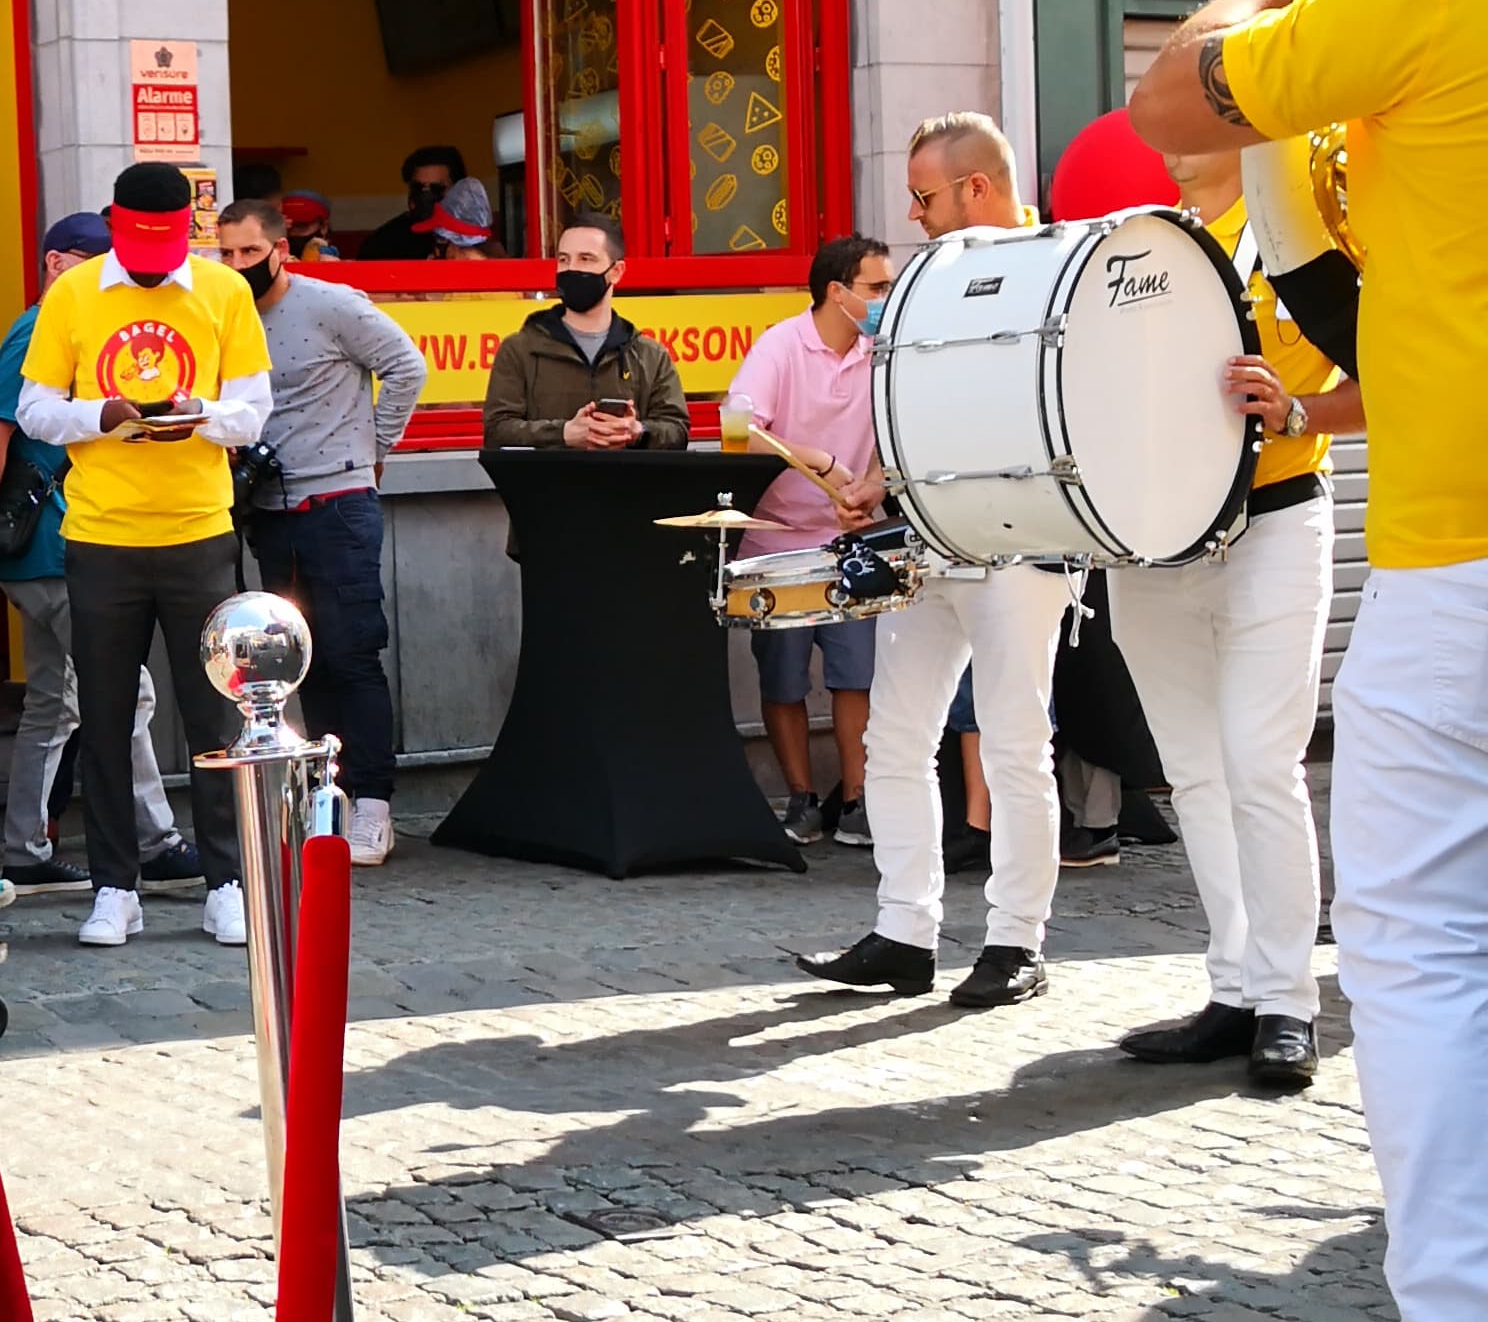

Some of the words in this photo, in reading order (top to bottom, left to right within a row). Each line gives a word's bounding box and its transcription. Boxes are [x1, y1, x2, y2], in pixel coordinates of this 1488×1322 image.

[137, 86, 193, 105] Alarme
[1106, 249, 1171, 308] Fame
[118, 322, 177, 344] BAGEL
